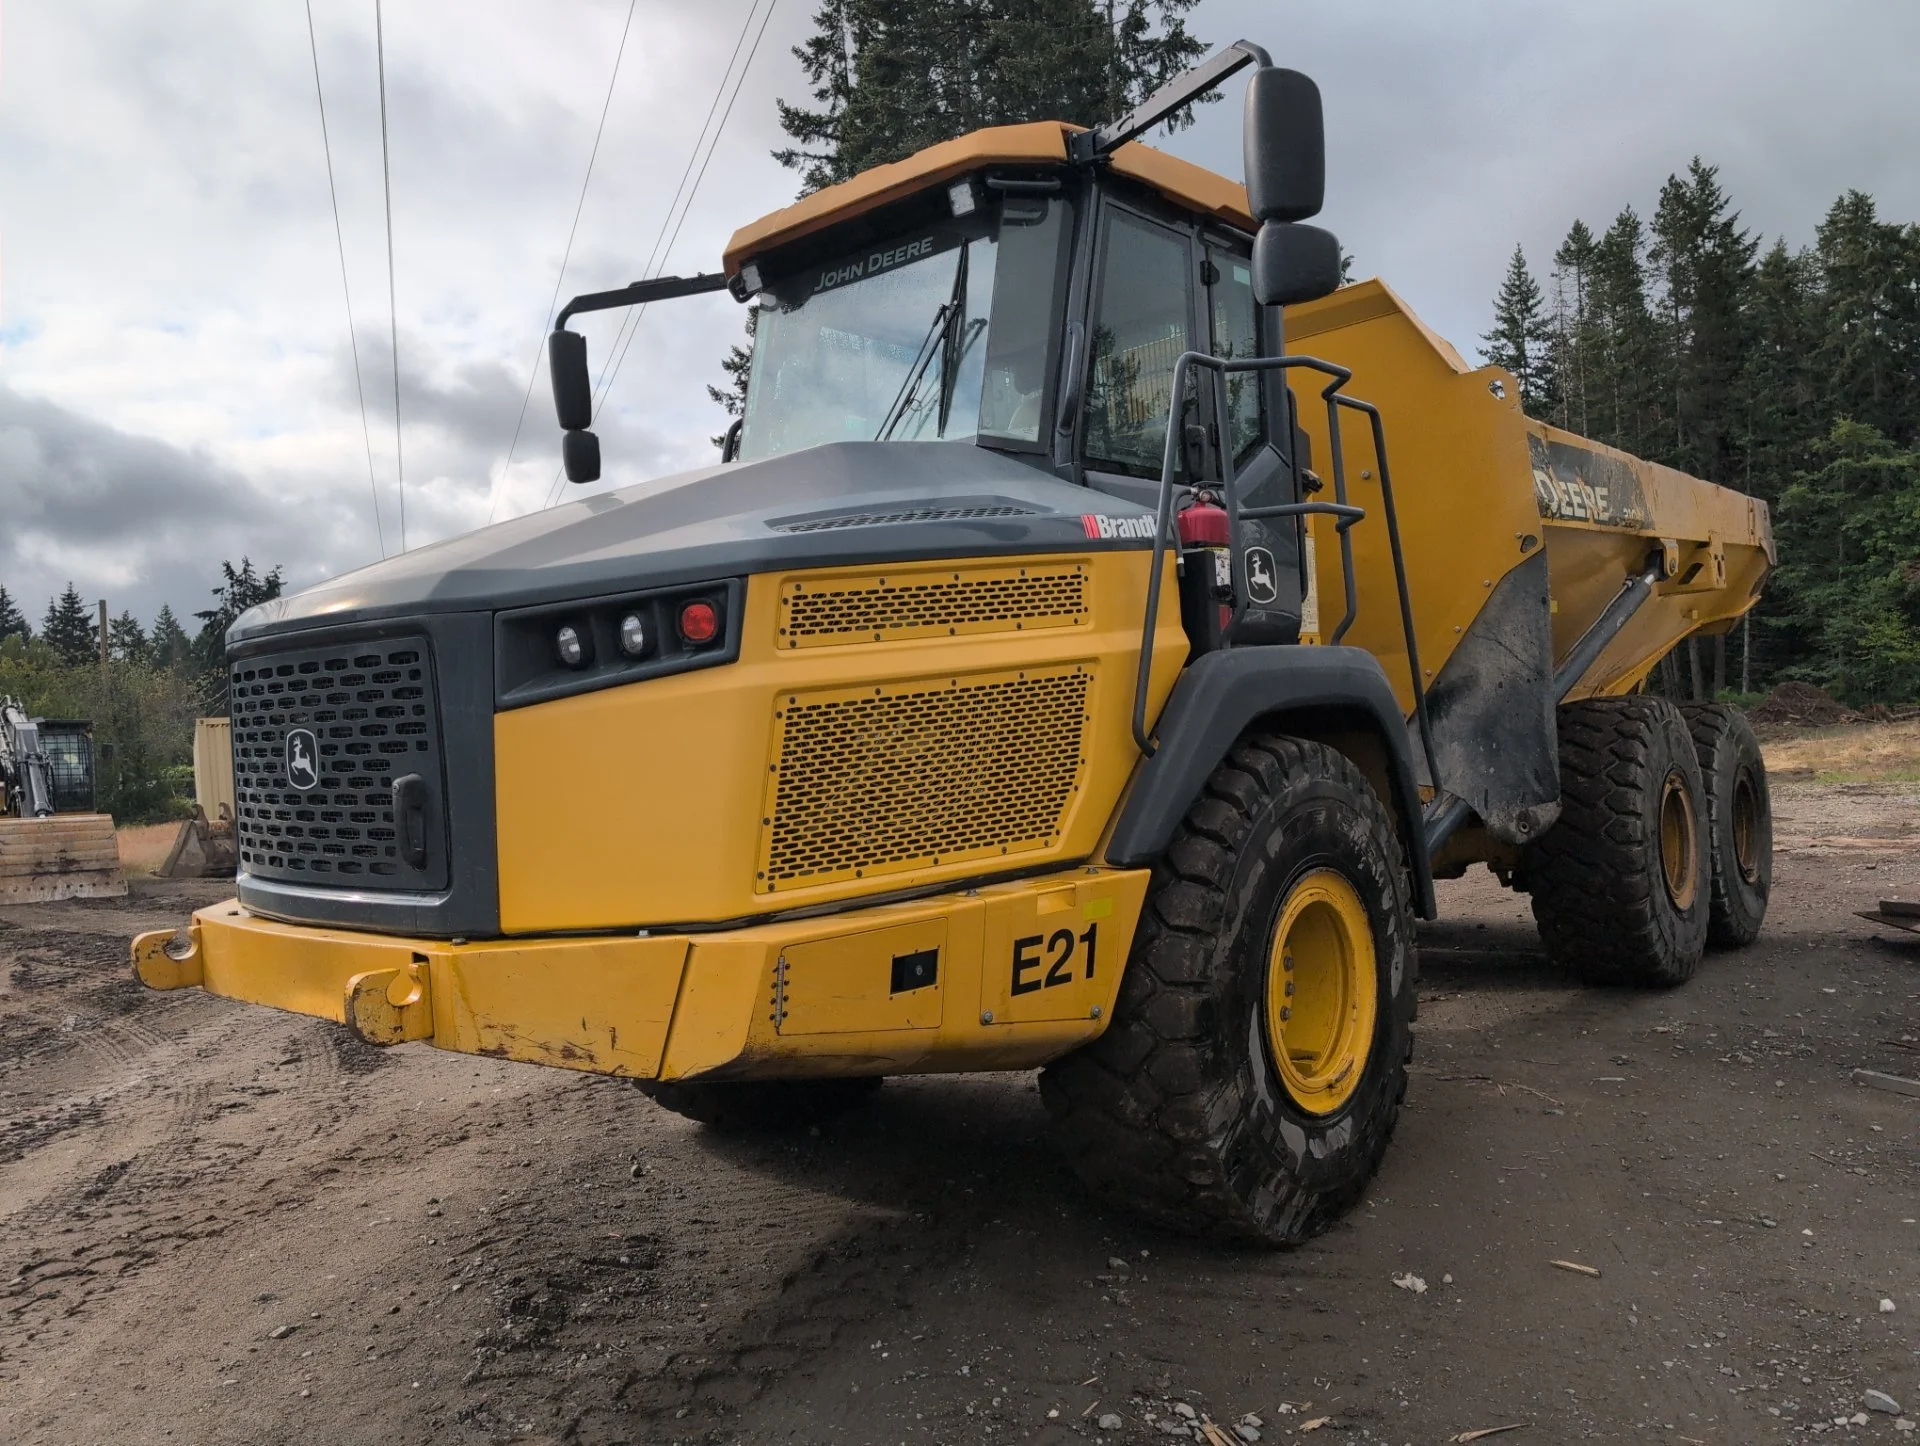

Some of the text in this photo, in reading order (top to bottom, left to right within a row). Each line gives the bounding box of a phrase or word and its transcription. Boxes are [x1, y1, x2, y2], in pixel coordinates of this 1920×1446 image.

[814, 236, 934, 292] JOHN DEERE
[1532, 469, 1610, 521] DEERE
[1010, 922, 1098, 997] E21
